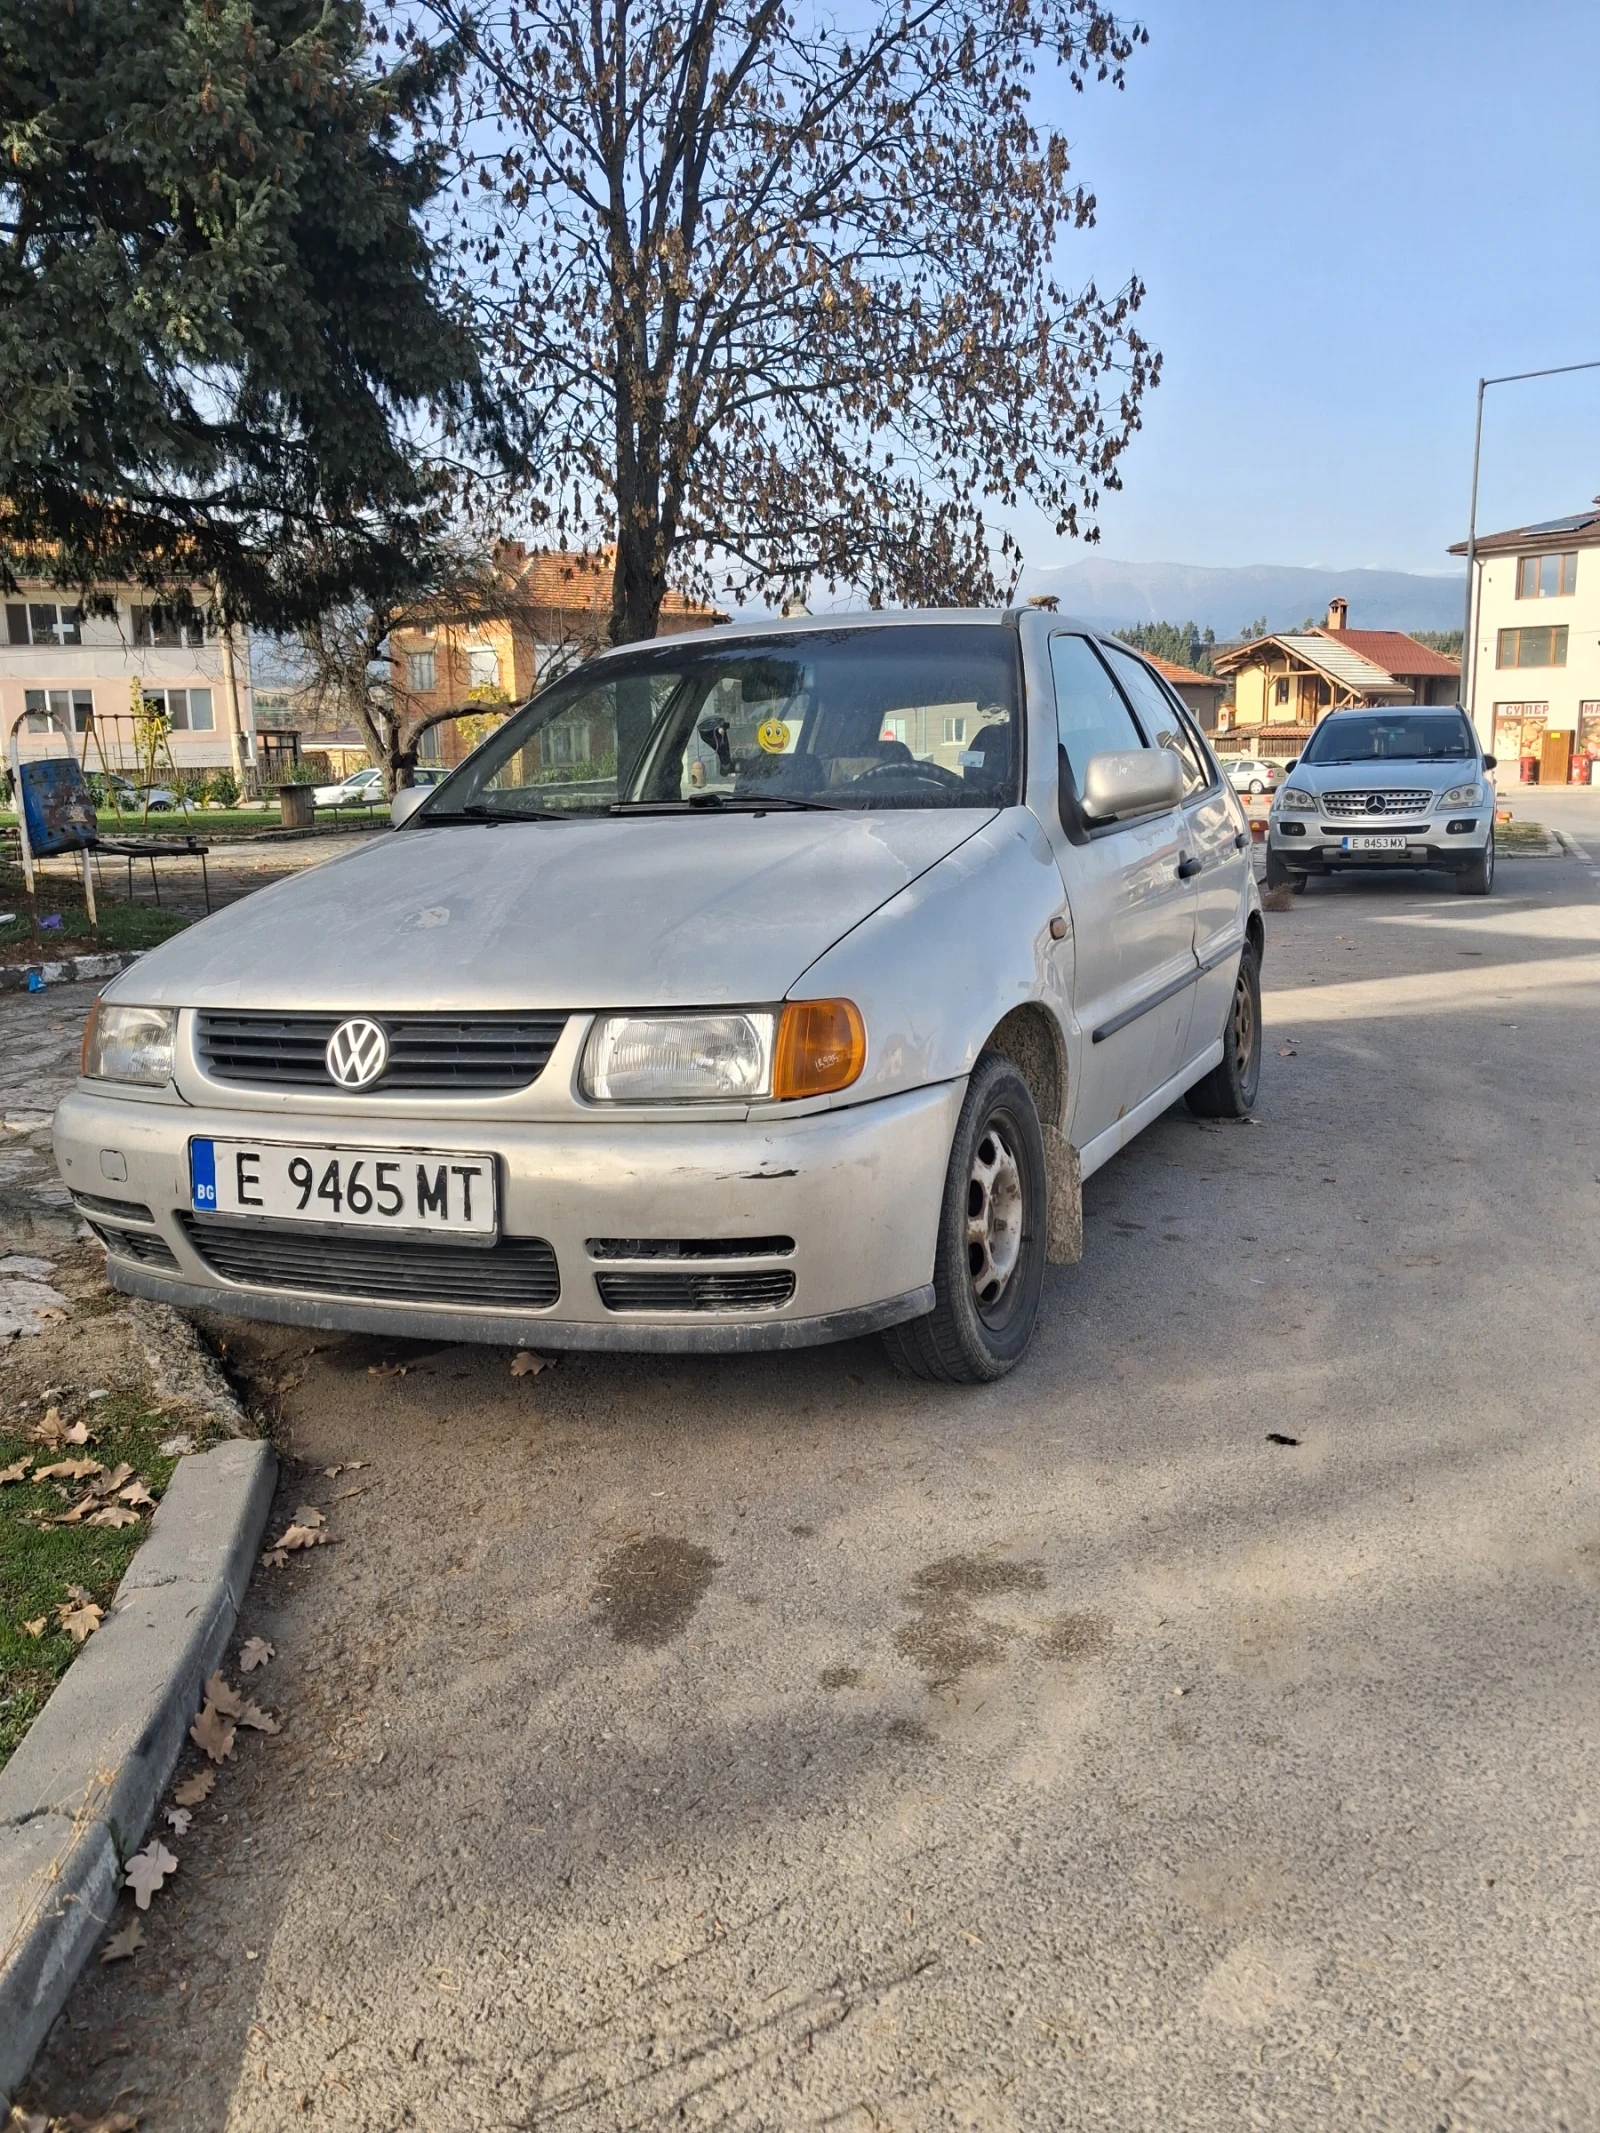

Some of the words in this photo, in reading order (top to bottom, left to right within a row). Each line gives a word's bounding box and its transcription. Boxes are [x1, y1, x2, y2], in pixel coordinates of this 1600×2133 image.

[1506, 704, 1549, 715] СУПЕР
[1352, 838, 1359, 848] E
[1364, 838, 1388, 848] 8453
[1390, 838, 1404, 848] MX
[197, 1183, 215, 1200] BG
[236, 1151, 264, 1207] E
[287, 1157, 403, 1217] 9465
[416, 1164, 483, 1222] MT
